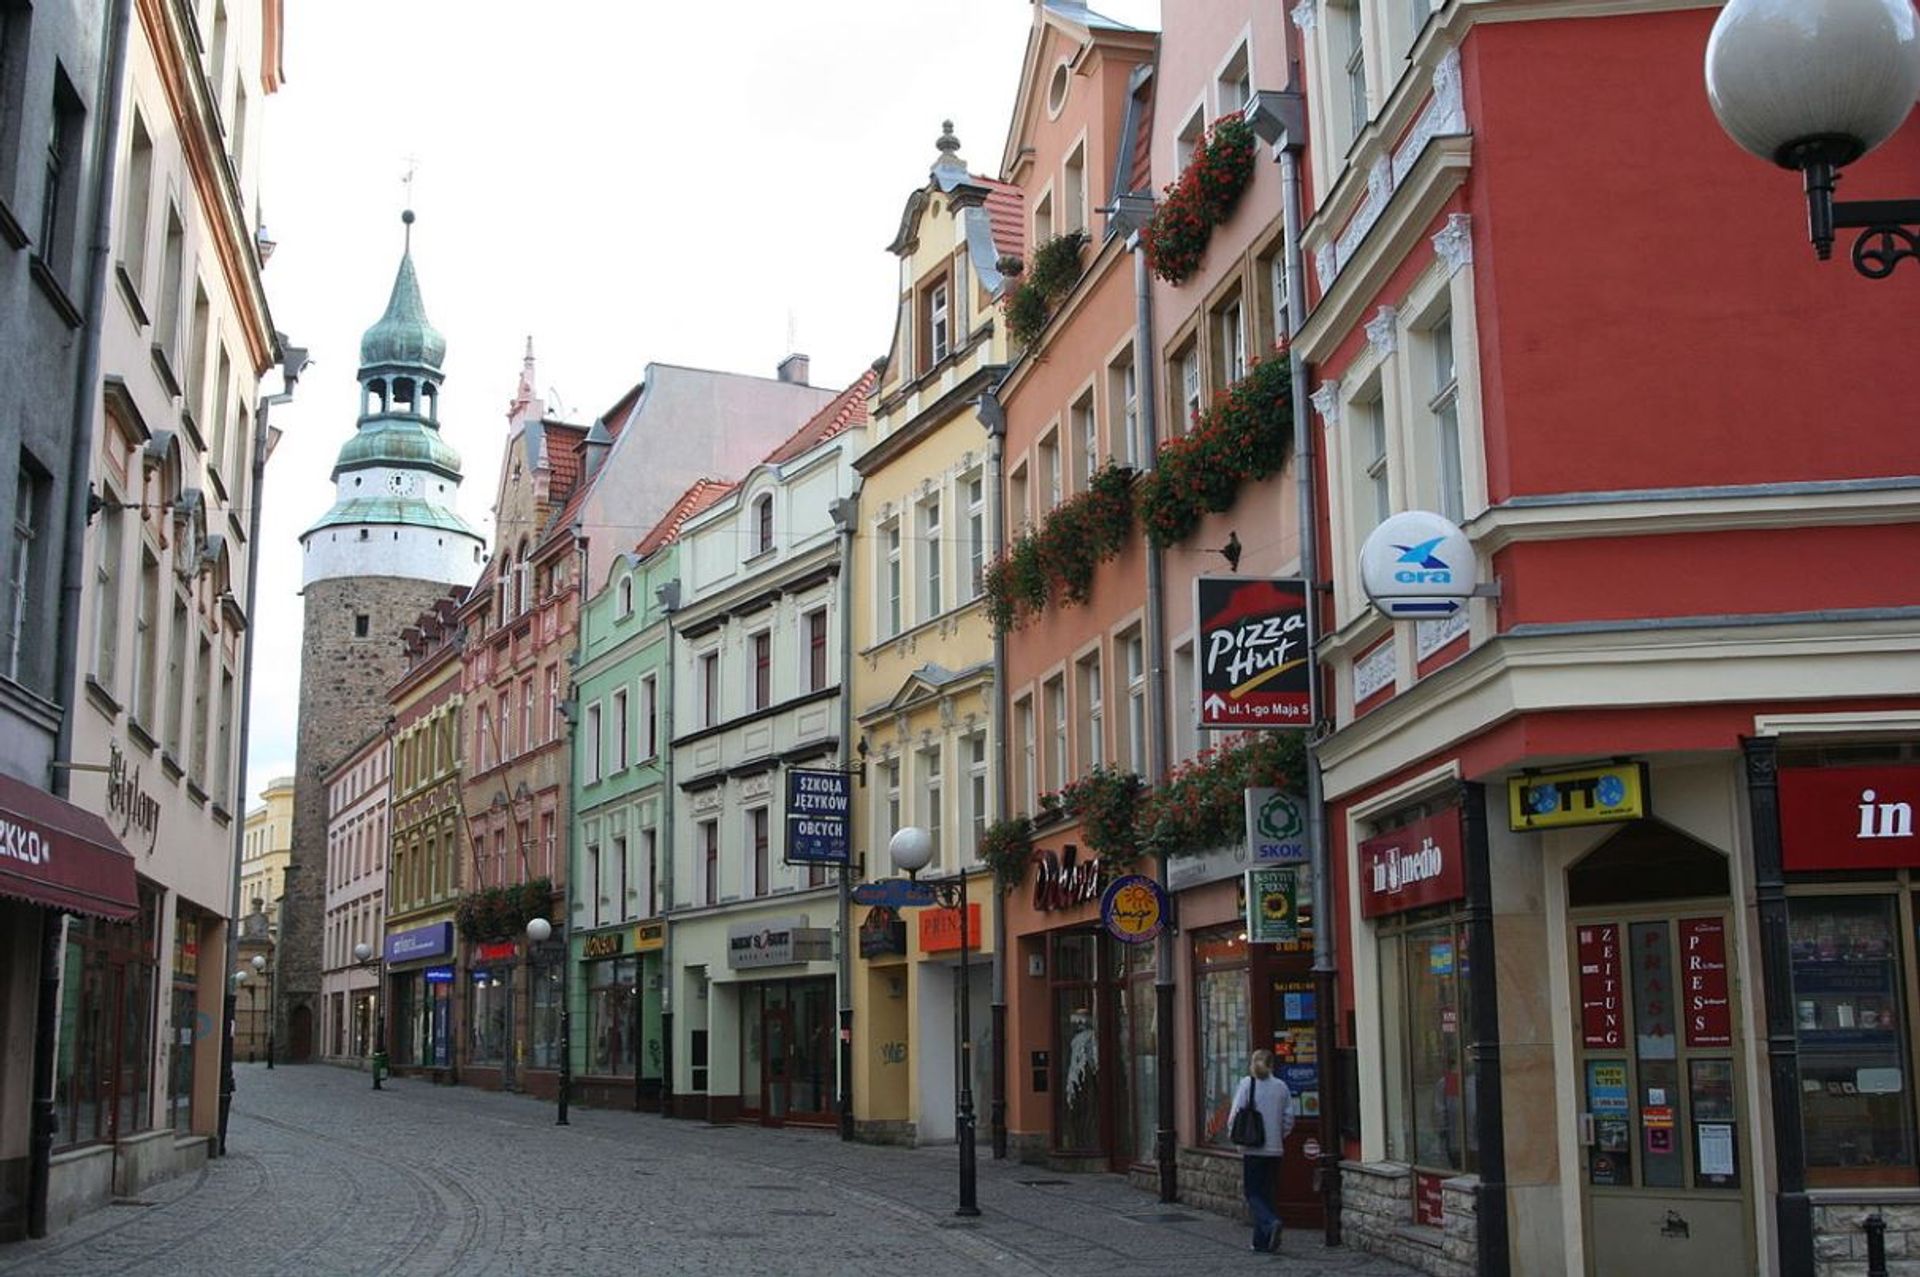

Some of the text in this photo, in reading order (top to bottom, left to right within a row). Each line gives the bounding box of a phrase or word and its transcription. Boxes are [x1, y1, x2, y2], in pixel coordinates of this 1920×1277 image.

[1395, 570, 1451, 584] era
[1208, 614, 1305, 675] Pizza
[1226, 638, 1298, 685] Hut
[1229, 703, 1309, 717] ul. 1-go Maja 5
[800, 777, 842, 793] SZKOŁA
[1520, 775, 1625, 816] LOTTO
[794, 793, 848, 811] JĘZYKÓW
[1857, 788, 1914, 839] in
[798, 821, 843, 837] OBCYCH
[1260, 844, 1303, 858] SKOK
[923, 914, 961, 935] PRIN
[1602, 928, 1618, 1043] ZEITUNG
[1689, 935, 1705, 1031] PRESS
